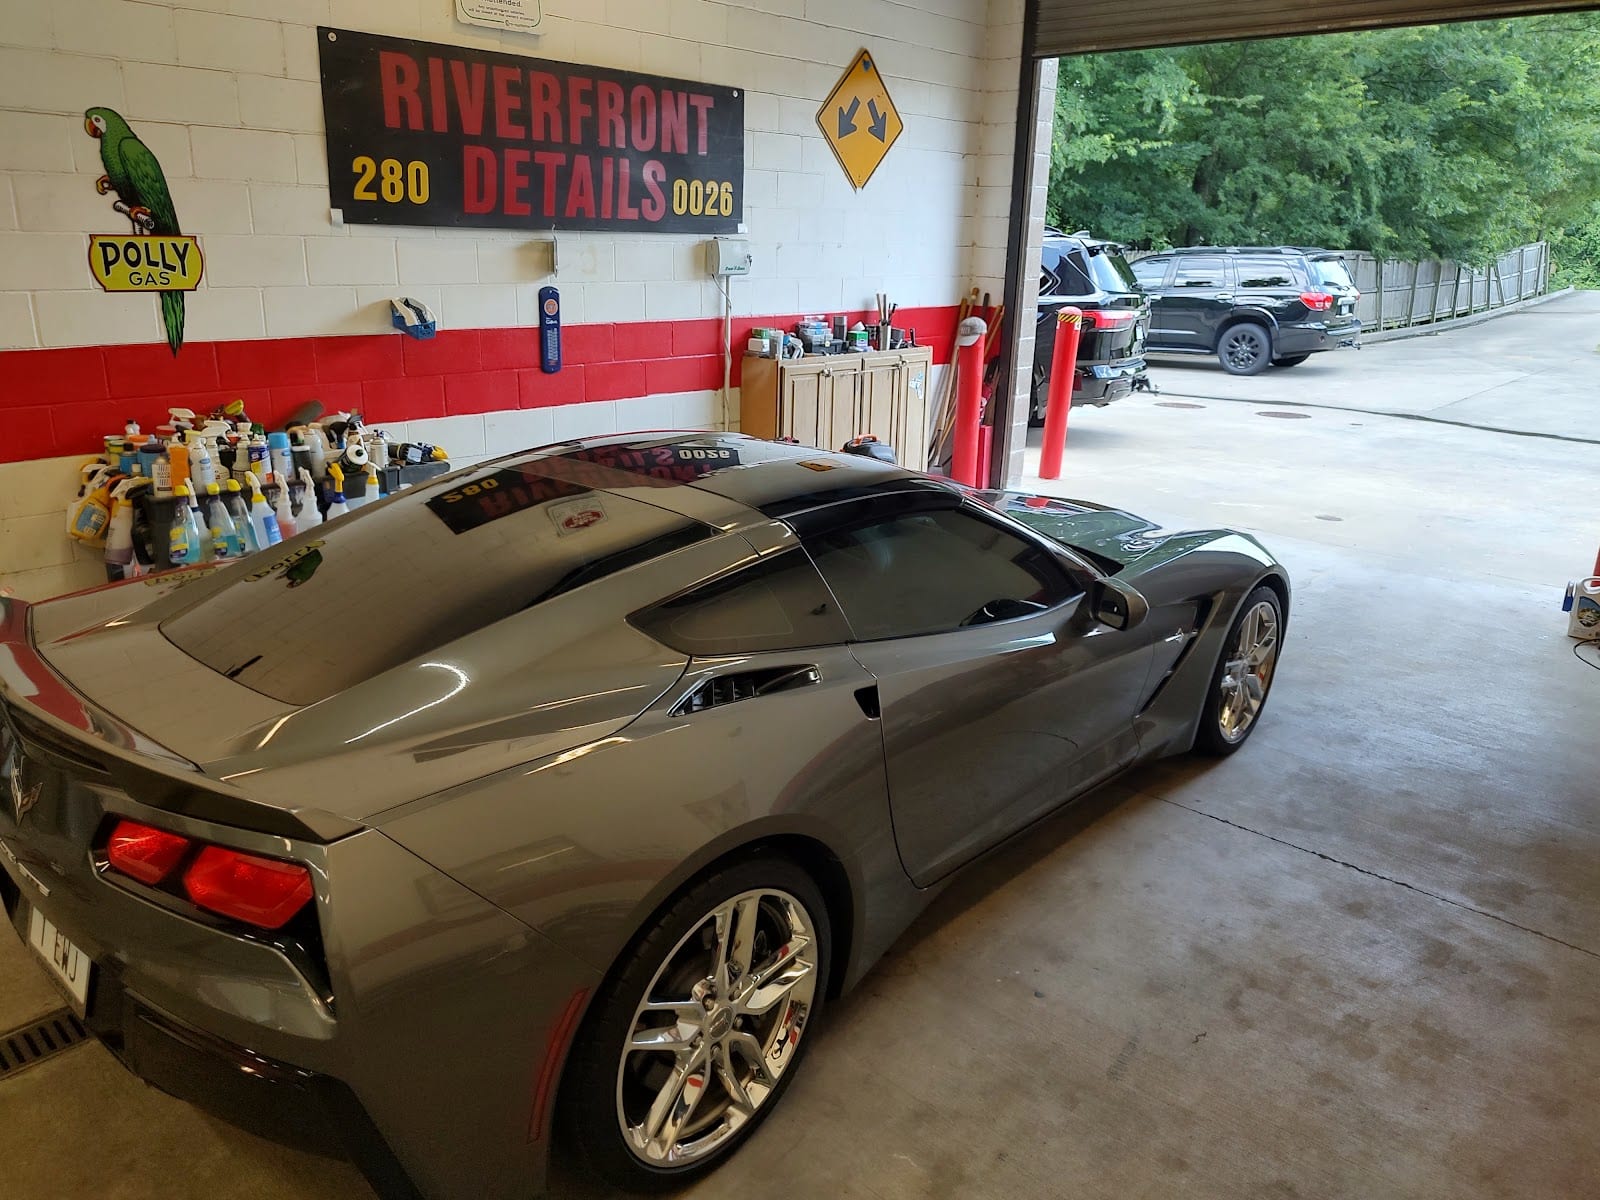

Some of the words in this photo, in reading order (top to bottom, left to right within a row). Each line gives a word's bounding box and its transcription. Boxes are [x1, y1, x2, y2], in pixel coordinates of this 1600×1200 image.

[379, 50, 714, 156] RIVERFRONT
[352, 155, 430, 204] 280
[462, 145, 667, 222] DETAILS
[673, 178, 734, 217] 0026
[98, 241, 190, 277] POLLY
[129, 272, 170, 286] GAS
